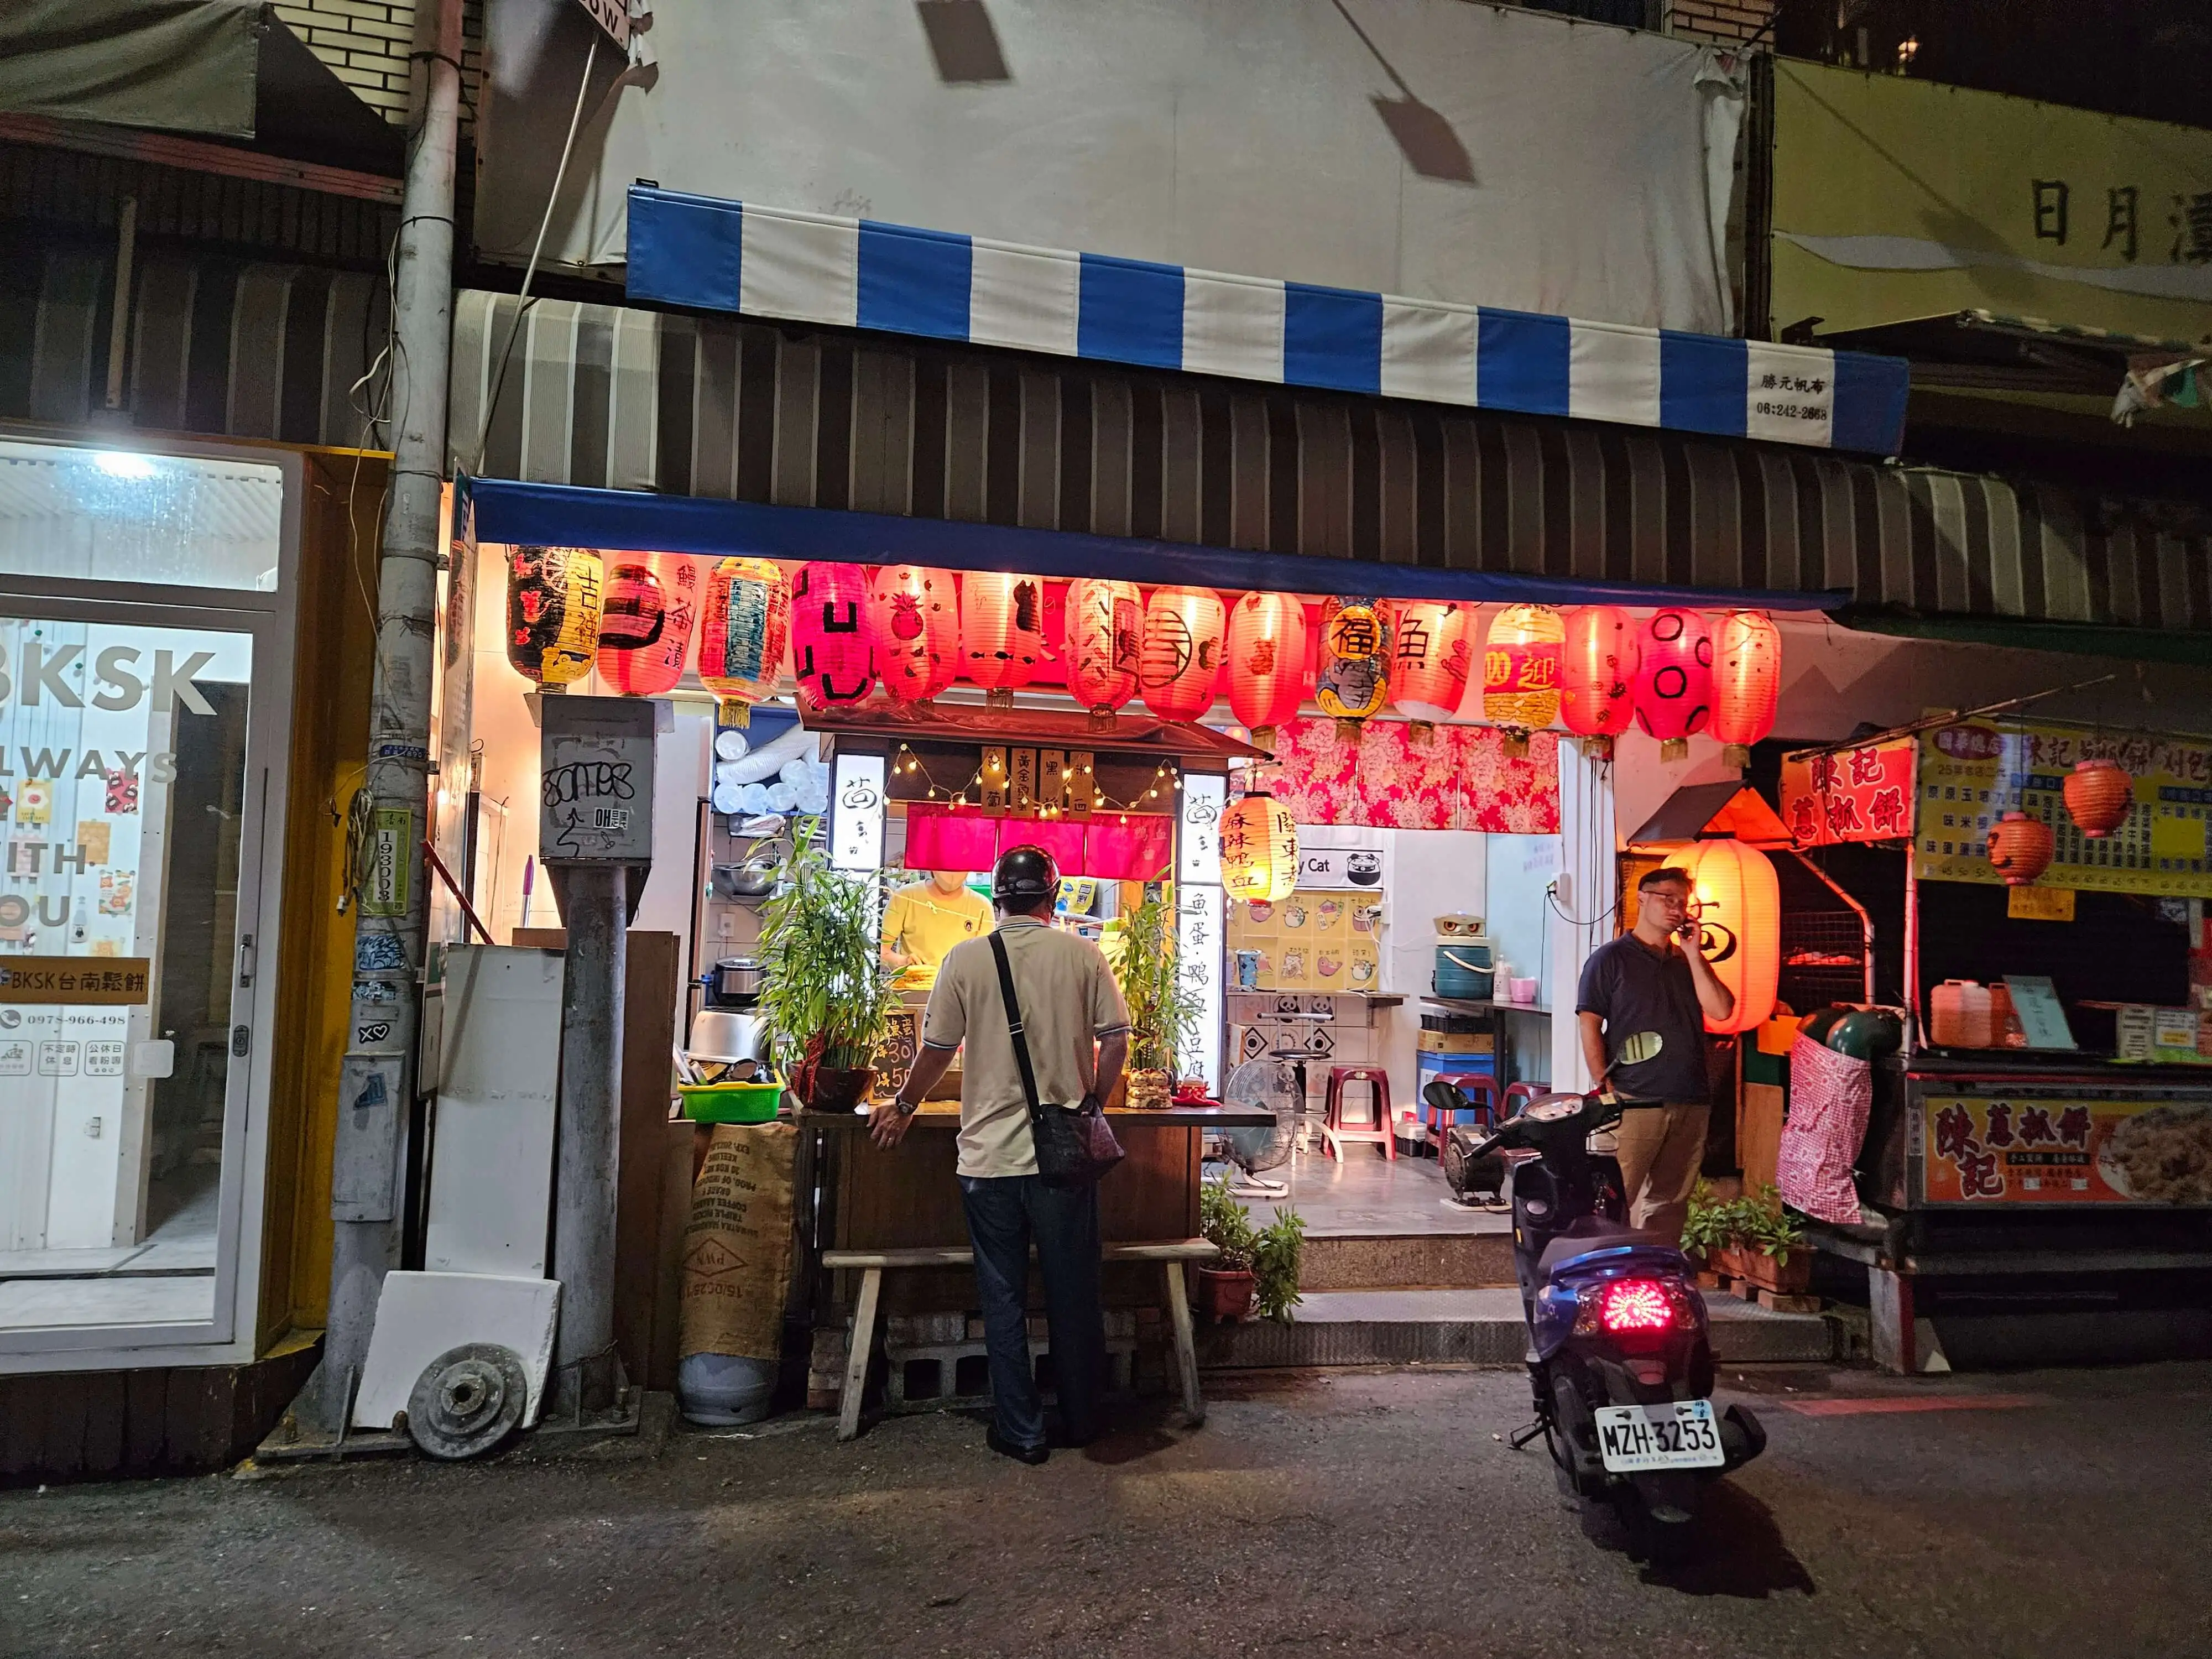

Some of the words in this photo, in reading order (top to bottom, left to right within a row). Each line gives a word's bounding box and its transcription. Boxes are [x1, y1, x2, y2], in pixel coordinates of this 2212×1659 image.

[1761, 373, 1825, 394] 勝元帆布
[1332, 615, 1374, 655] 福
[1396, 609, 1430, 670] 魚
[0, 641, 217, 716] KSK
[0, 744, 178, 783] LWAYS
[0, 842, 87, 874] ITH
[1308, 858, 1329, 873] Cat
[0, 894, 70, 927] OU
[89, 1044, 122, 1053] 公休日
[1602, 1418, 1715, 1456] MZH-3253
